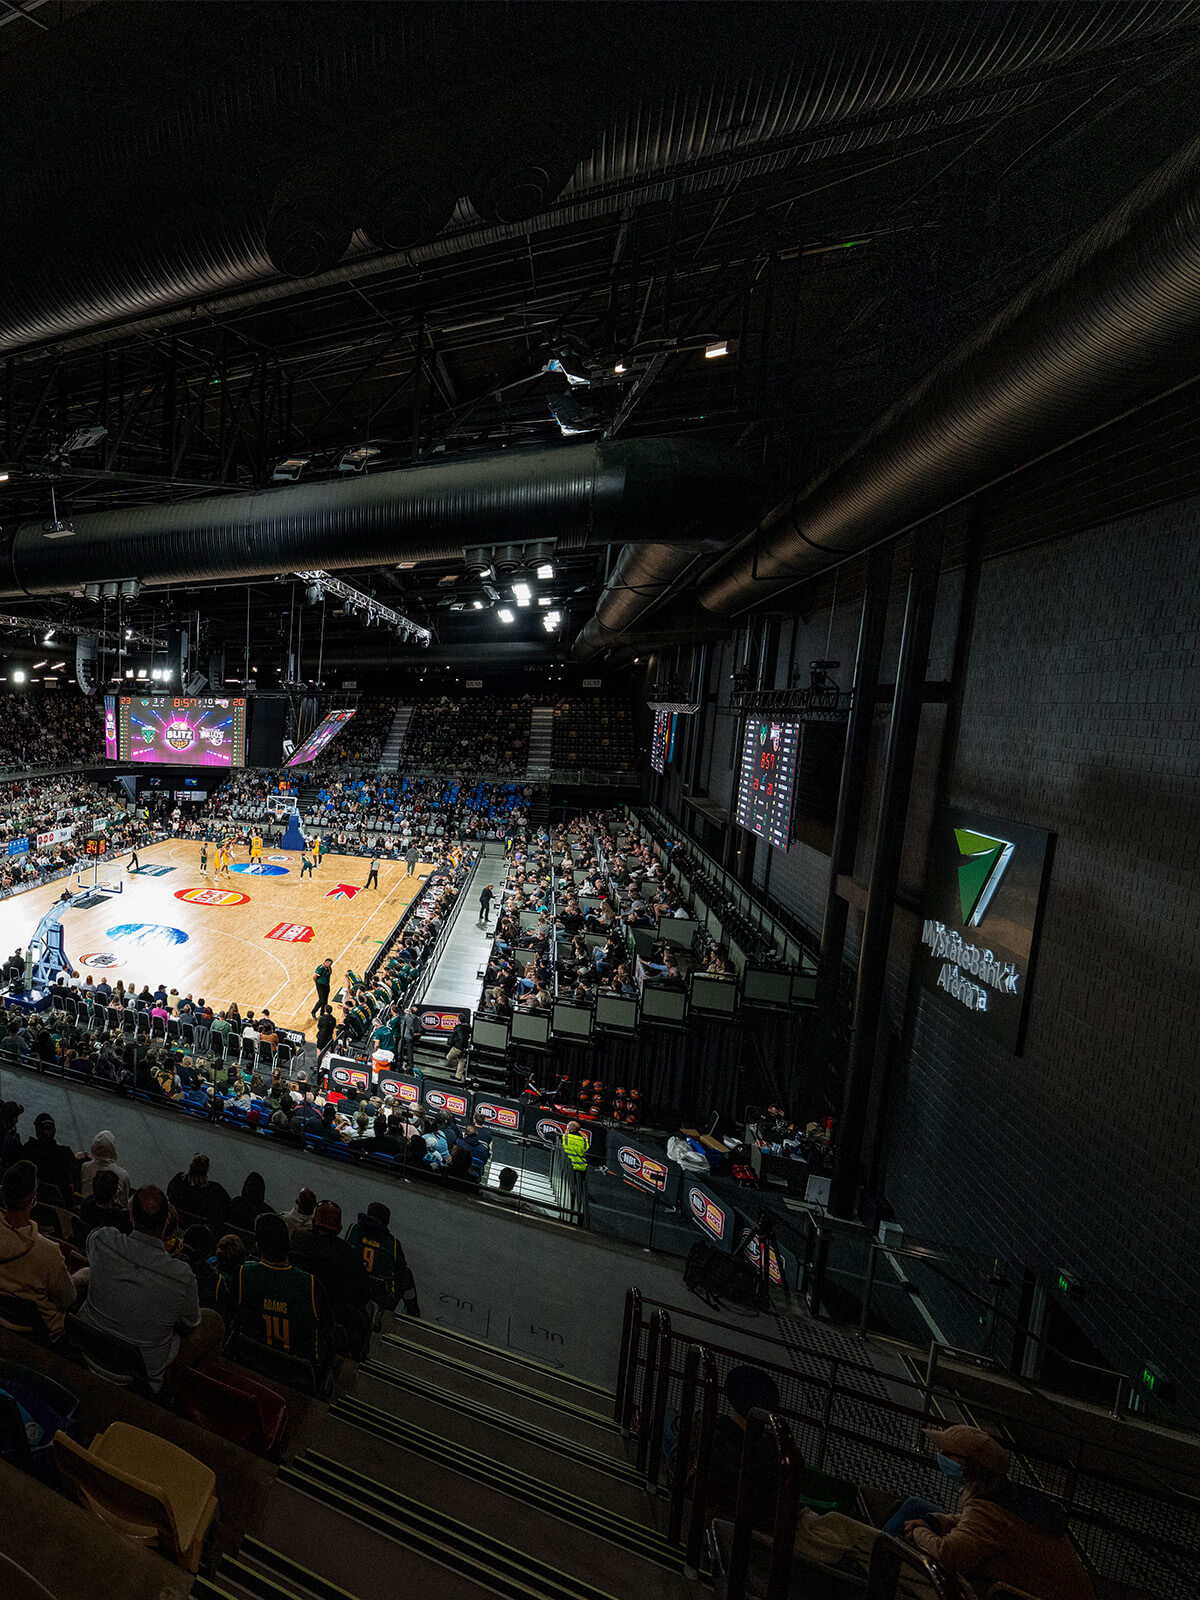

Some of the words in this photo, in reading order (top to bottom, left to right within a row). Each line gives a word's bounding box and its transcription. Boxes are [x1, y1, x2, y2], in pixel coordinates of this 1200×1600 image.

[121, 697, 131, 705] 23
[173, 698, 197, 708] 8:57
[232, 698, 245, 706] 20
[166, 730, 193, 739] BLITZ
[760, 752, 775, 770] 8:57
[86, 844, 97, 854] 24
[936, 963, 988, 1012] Arena
[425, 1016, 437, 1025] NBL
[336, 1071, 347, 1080] NBL
[385, 1083, 396, 1092] NBL
[430, 1095, 442, 1104] NBL
[480, 1107, 493, 1117] NBL
[623, 1153, 637, 1166] NBL
[692, 1194, 703, 1212] NBL
[363, 1247, 376, 1273] 9
[263, 1298, 288, 1314] ADAMS
[439, 1293, 473, 1312] UL2
[261, 1314, 291, 1349] 14
[530, 1324, 564, 1345] UL1
